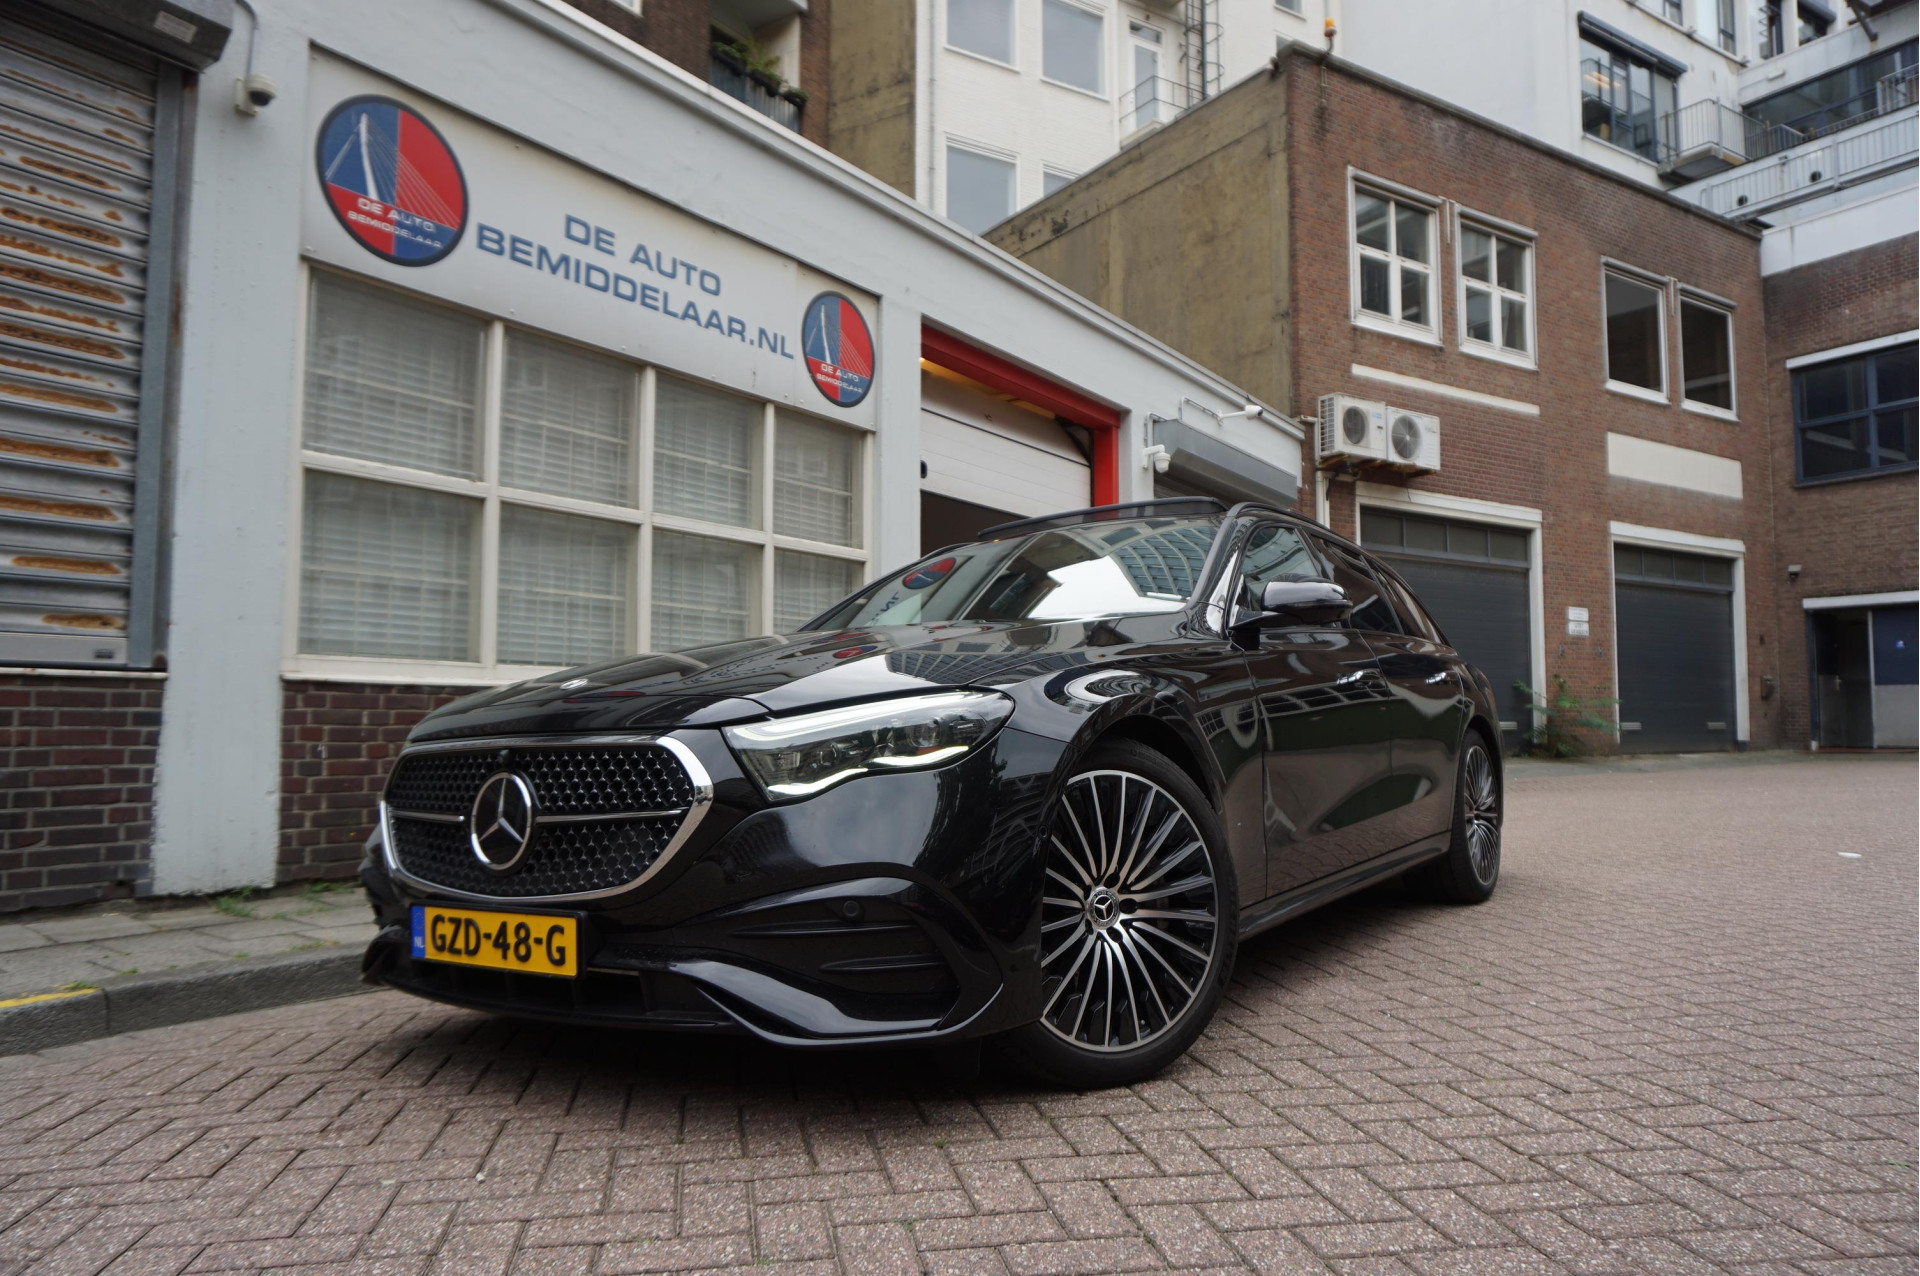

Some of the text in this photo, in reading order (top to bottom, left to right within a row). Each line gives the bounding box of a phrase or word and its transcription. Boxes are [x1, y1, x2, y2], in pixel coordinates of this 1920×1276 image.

[347, 211, 443, 248] BEMIDDELAAR
[357, 197, 436, 232] DE AUTO
[565, 213, 721, 296] DE AUTO
[477, 222, 794, 359] BEMIDDELAAR.NL
[821, 363, 859, 382] DE AUTO
[414, 936, 425, 948] NL
[430, 914, 567, 966] GZD-48-G
